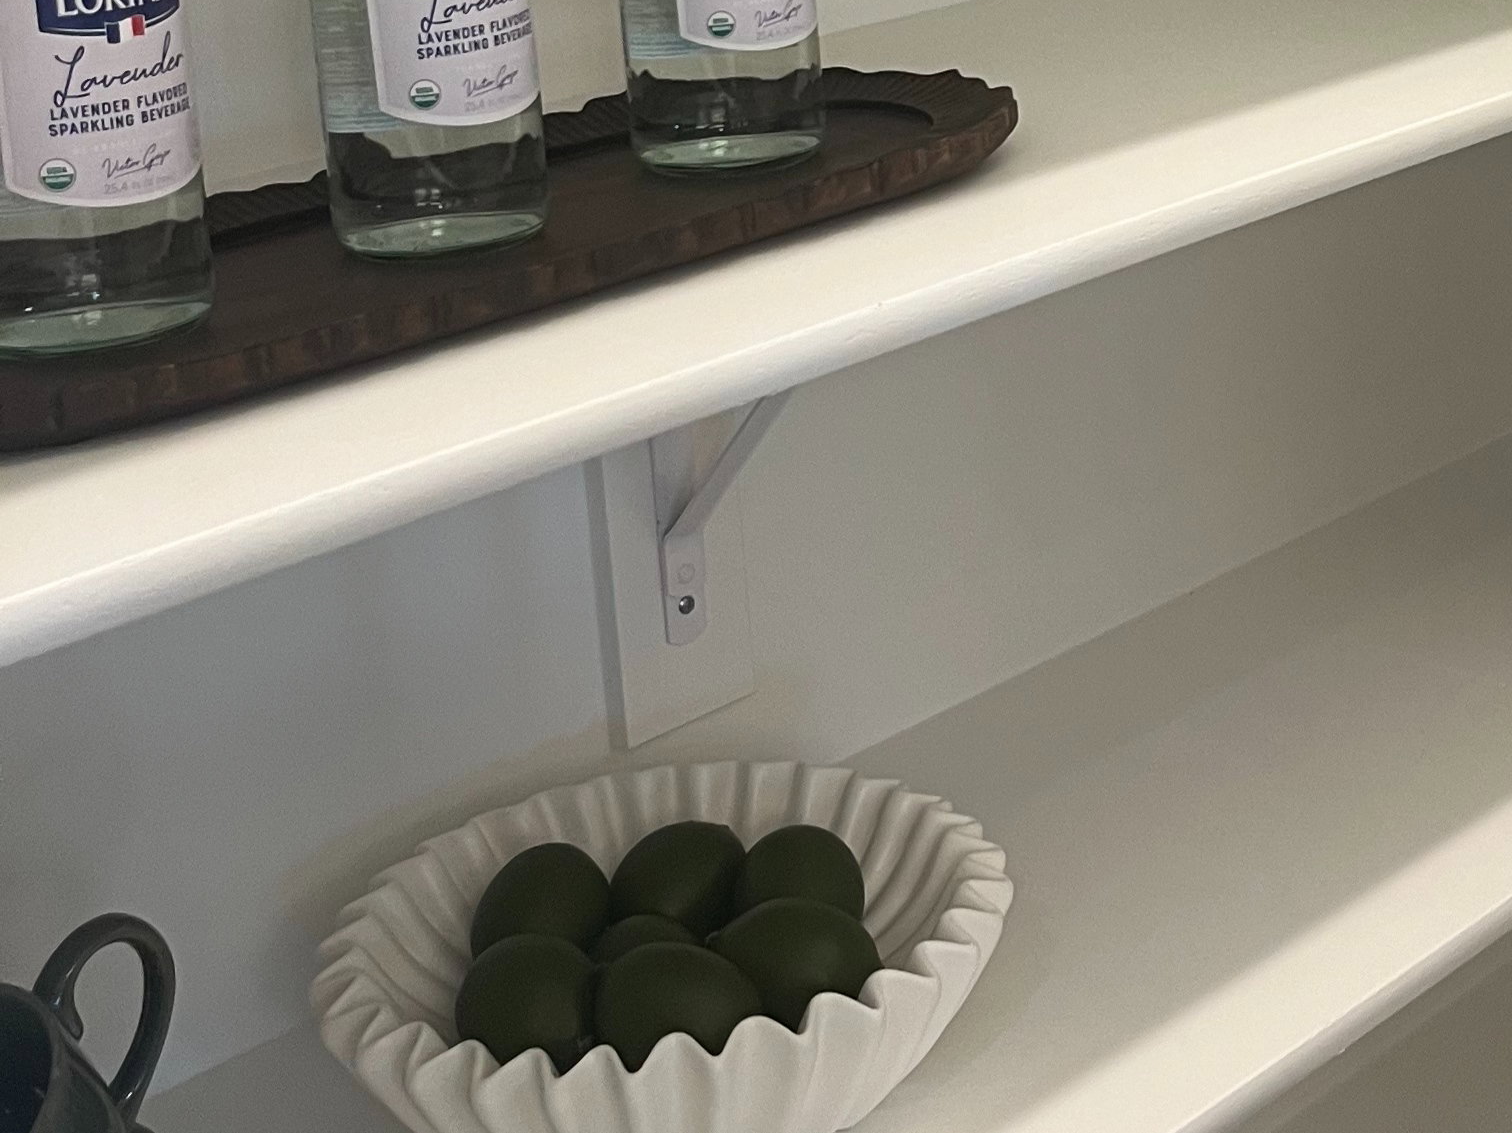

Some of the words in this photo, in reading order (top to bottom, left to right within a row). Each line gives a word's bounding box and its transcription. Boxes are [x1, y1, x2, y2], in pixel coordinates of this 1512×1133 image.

[416, 38, 490, 60] SPARKLING
[417, 22, 485, 46] LAVENDER
[53, 30, 184, 108] Lavender
[48, 113, 135, 138] SPARKLING
[141, 98, 191, 124] BEVERAGE
[50, 97, 131, 122] LAVENDER
[136, 82, 188, 108] FLAVORED
